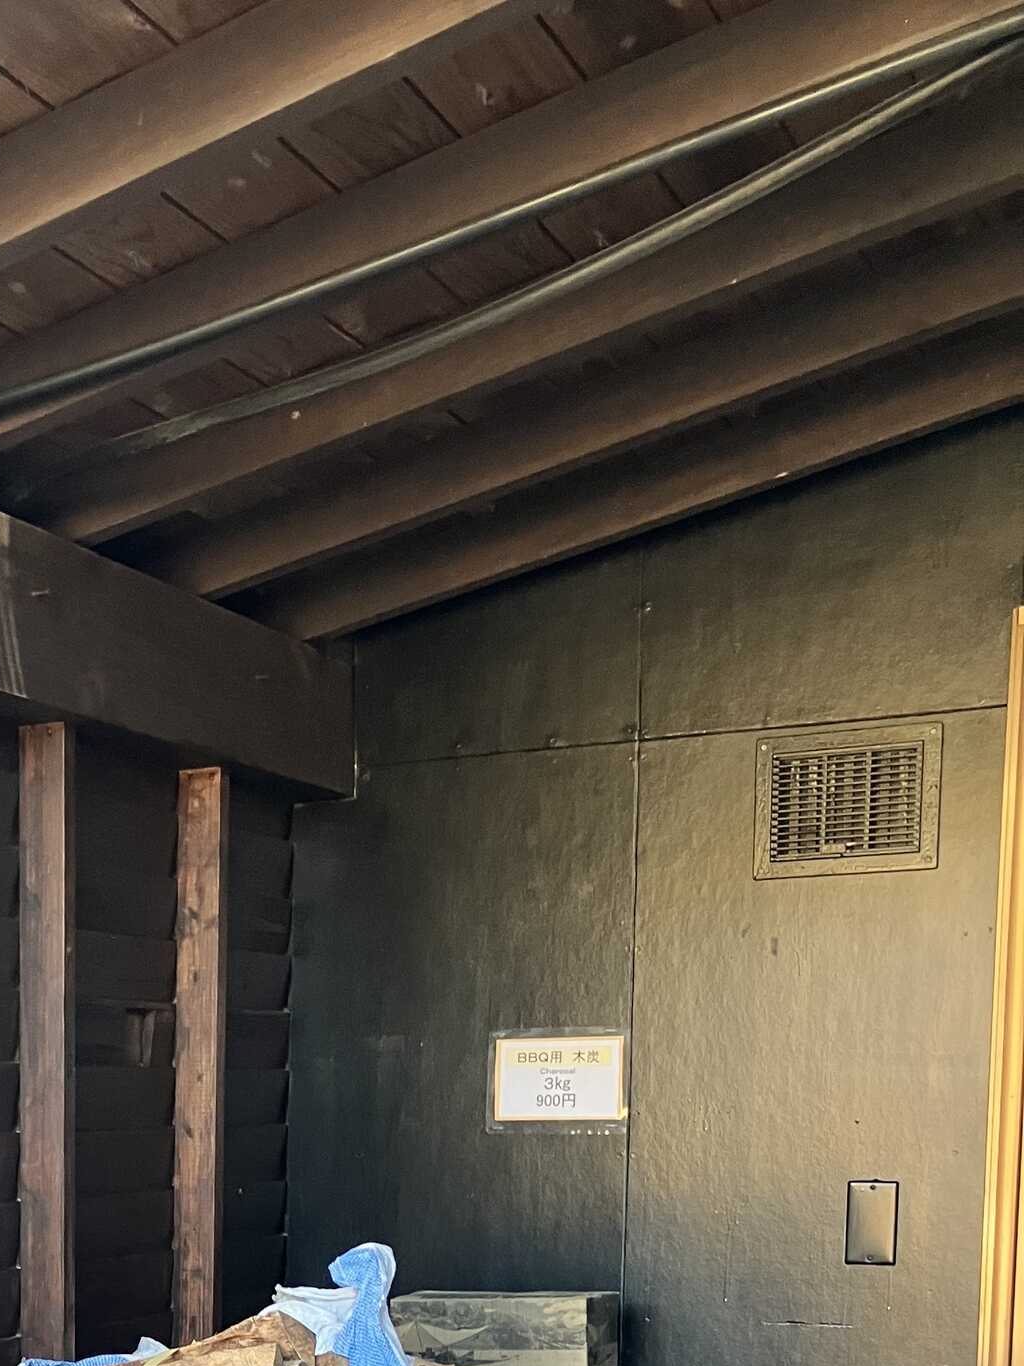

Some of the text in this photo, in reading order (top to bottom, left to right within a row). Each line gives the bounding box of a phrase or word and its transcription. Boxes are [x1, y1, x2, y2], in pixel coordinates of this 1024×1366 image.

[517, 1050, 600, 1064] BBQ用 木炭
[544, 1077, 571, 1091] 3kg
[536, 1094, 576, 1108] 900円
